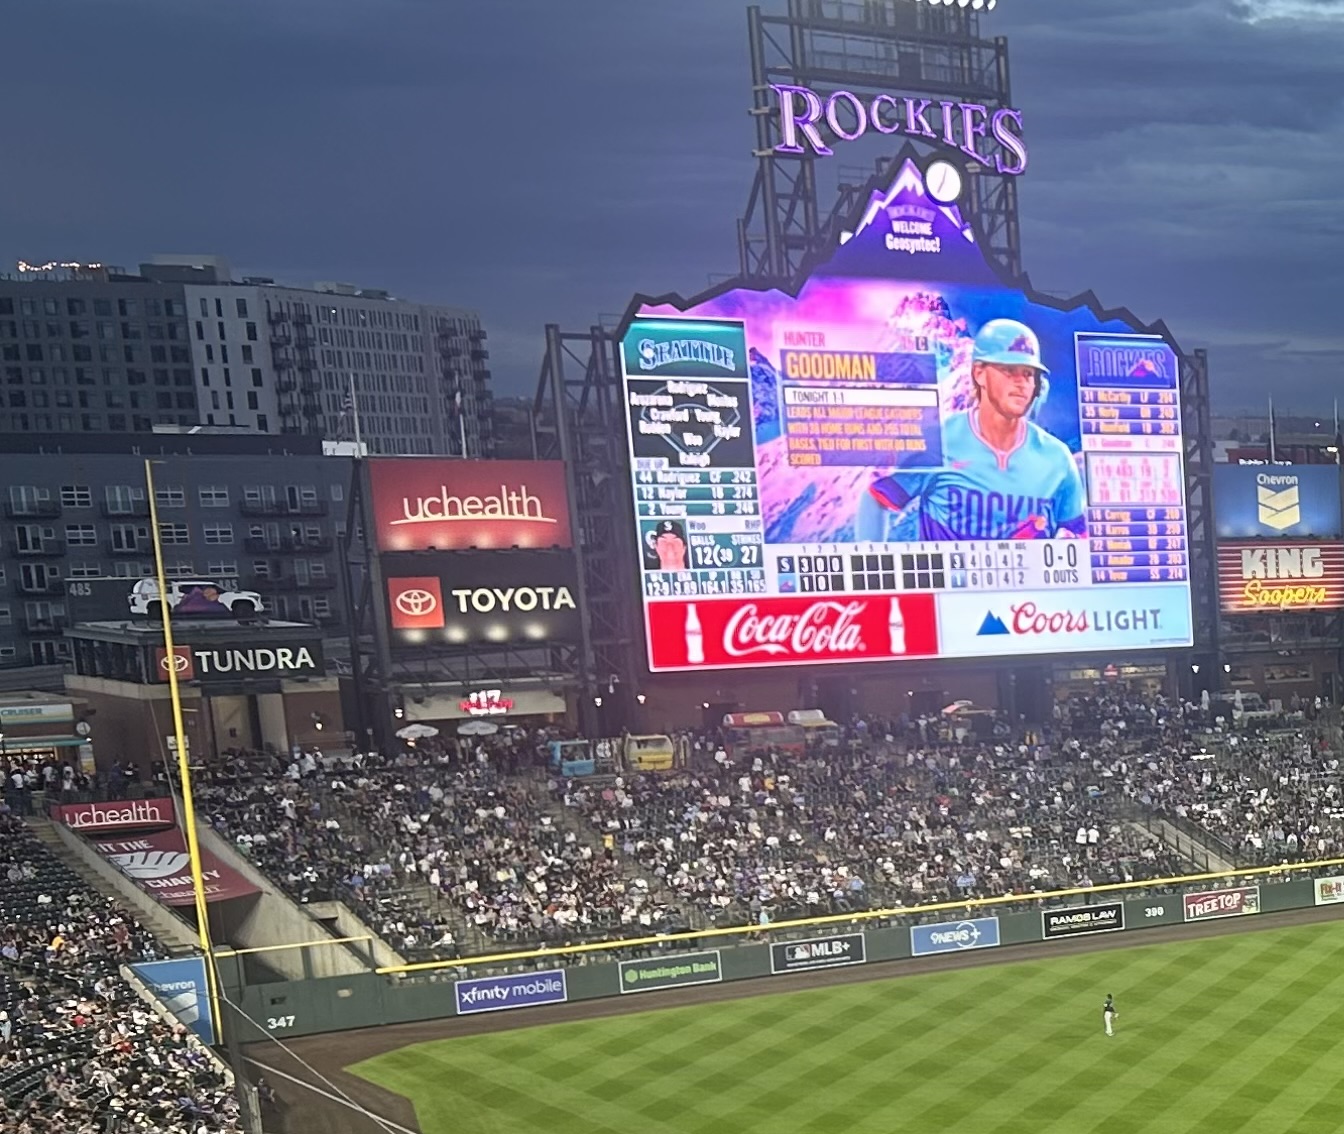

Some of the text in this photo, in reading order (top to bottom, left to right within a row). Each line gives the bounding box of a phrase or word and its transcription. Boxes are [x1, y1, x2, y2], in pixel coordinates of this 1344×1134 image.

[769, 83, 1028, 174] ROCKIES
[892, 221, 933, 235] WELCOME
[885, 235, 941, 254] Geosyntec!
[783, 331, 825, 347] HUNTER
[638, 338, 736, 372] SEATTLE
[785, 352, 877, 380] GOODMAN
[792, 390, 829, 403] TONIGHT
[1257, 473, 1299, 485] Chevron
[403, 484, 544, 520] uchealth
[641, 487, 655, 499] 12
[695, 546, 758, 565] 12 27
[1241, 548, 1325, 579] KING
[1053, 570, 1079, 584] OUTS
[69, 583, 92, 596] 485
[1243, 581, 1327, 611] Soopers
[452, 587, 576, 613] TOYOTA
[722, 601, 866, 656] Coca-Cola
[1010, 602, 1161, 636] Coors LIGHT
[195, 647, 316, 673] TUNDRA
[64, 801, 160, 826] uchealth
[120, 838, 154, 851] THE
[1050, 911, 1091, 926] RAMOS
[1091, 909, 1117, 922] LAW
[638, 961, 717, 981] Huntington Bank
[461, 978, 562, 1005] xfinity mobile
[266, 1015, 296, 1029] 347
